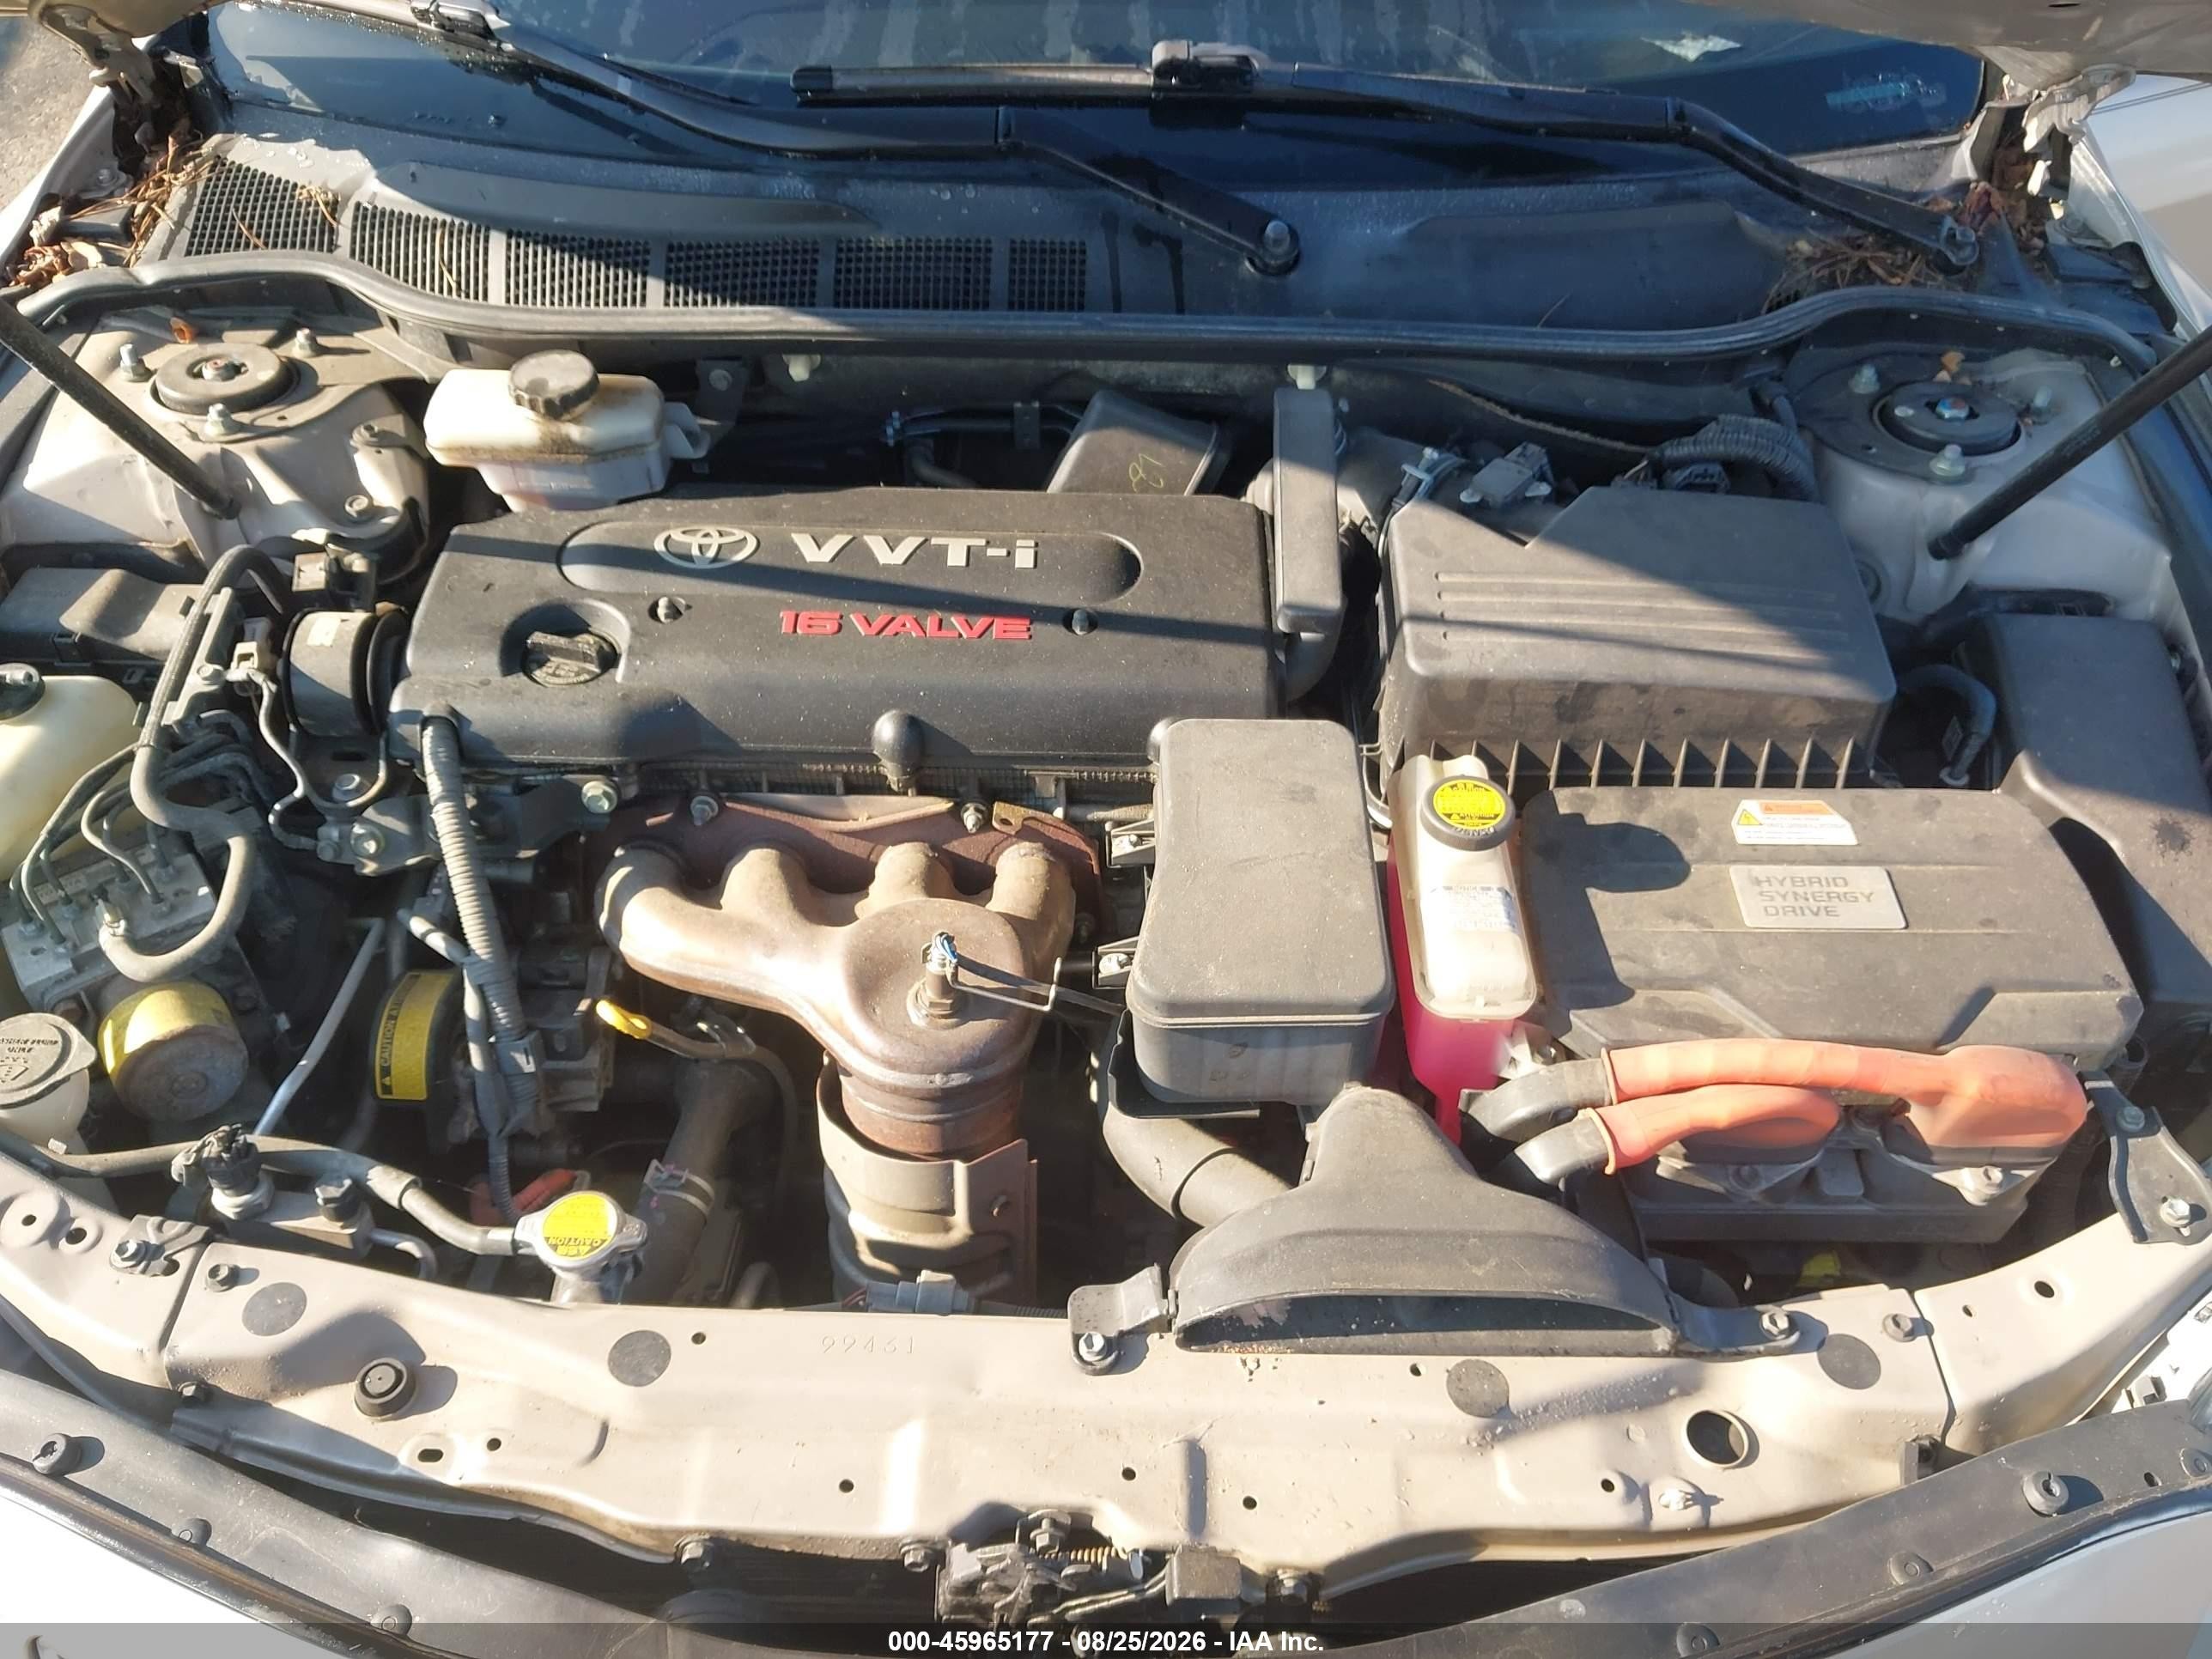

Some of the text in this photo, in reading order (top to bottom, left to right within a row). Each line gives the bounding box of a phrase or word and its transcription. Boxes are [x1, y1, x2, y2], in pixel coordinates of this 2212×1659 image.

[790, 532, 1037, 569] VVT-i
[780, 611, 1032, 640] 16 VALVE
[1753, 876, 1849, 888] HYBRID
[1759, 890, 1875, 902] SYNERGY
[1764, 905, 1841, 917] DRIVE
[380, 1018, 397, 1066] CAUTION
[548, 1237, 602, 1246] CAUTION
